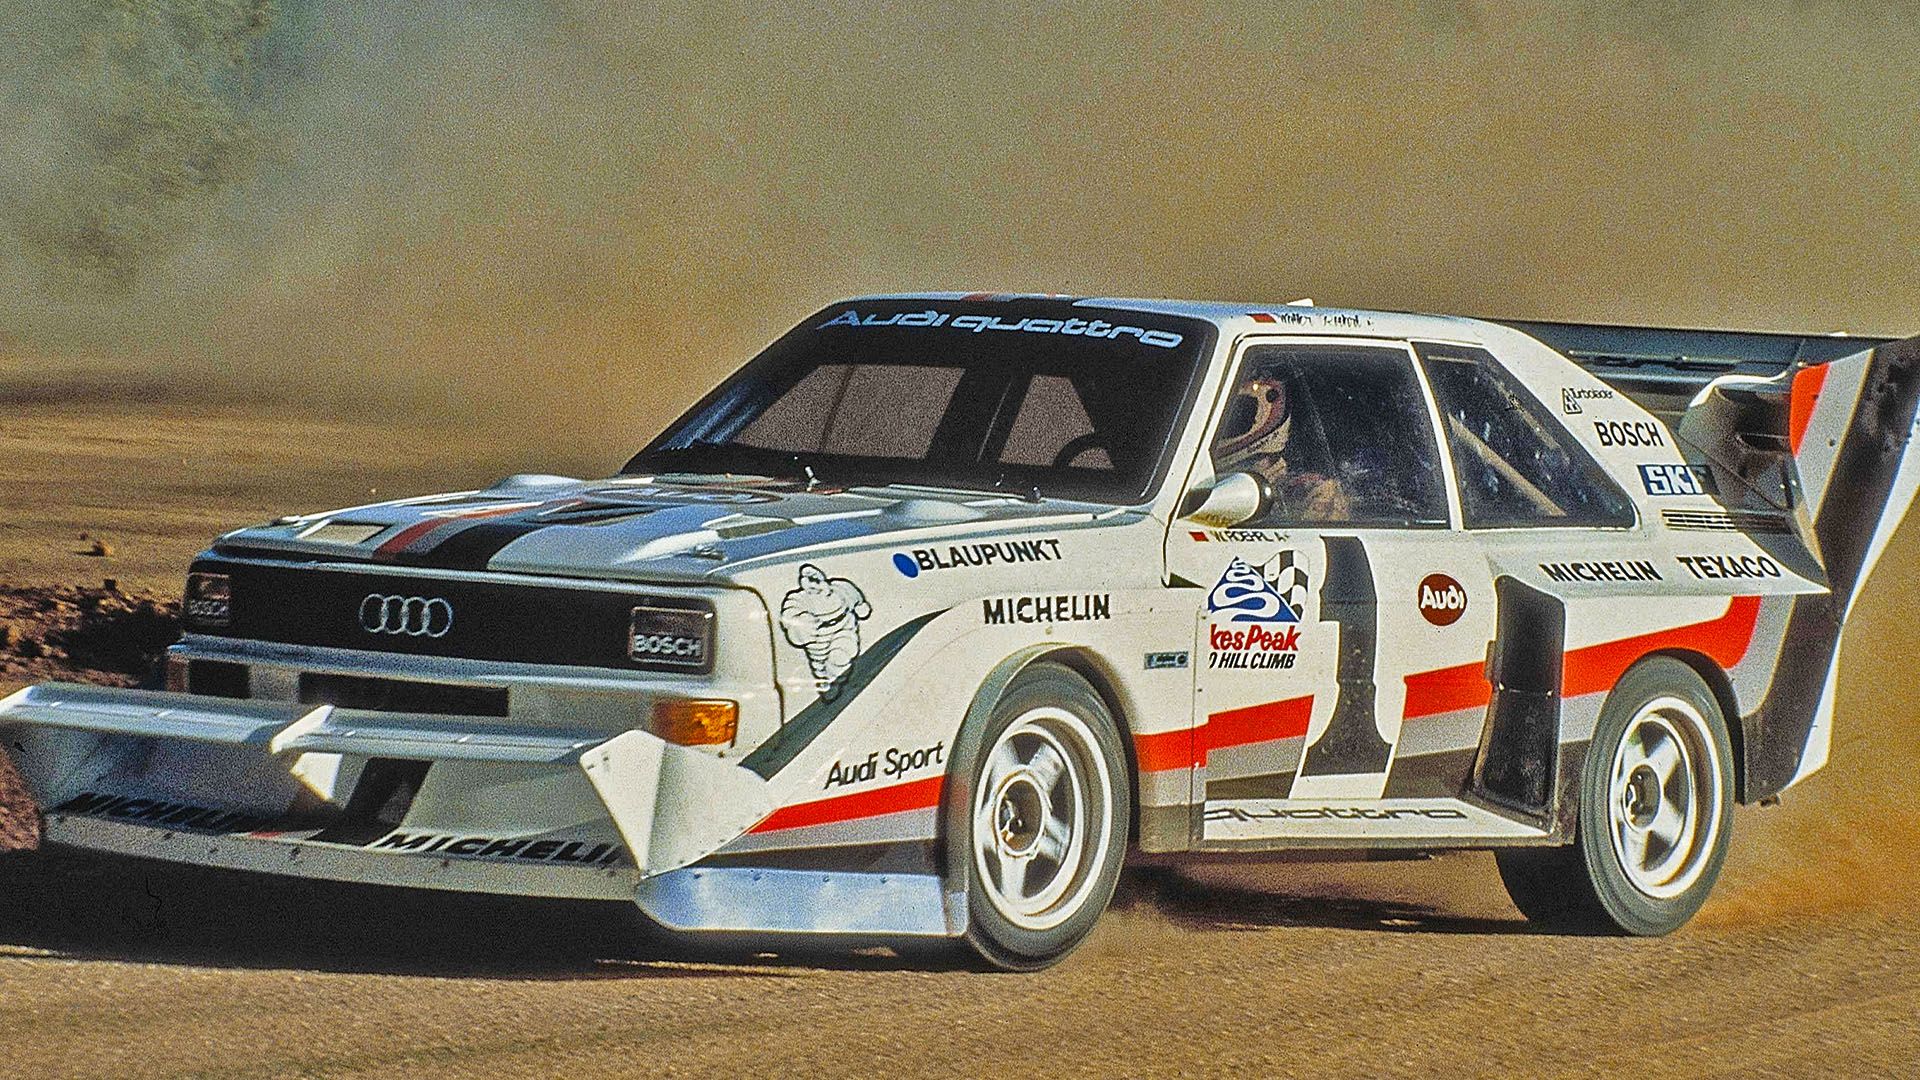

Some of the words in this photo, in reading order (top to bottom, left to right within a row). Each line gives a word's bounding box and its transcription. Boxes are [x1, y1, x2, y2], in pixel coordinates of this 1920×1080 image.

[815, 310, 945, 330] Audi
[949, 313, 1184, 348] quattro
[1595, 421, 1664, 447] BOSCH
[912, 539, 1064, 570] BLAUPUNKT
[1539, 560, 1663, 581] MICHELIN
[1676, 556, 1781, 579] TEXACO
[983, 594, 1110, 625] MICHELIN
[1420, 585, 1464, 609] Audi
[633, 634, 702, 656] BOSCH
[1244, 624, 1301, 651] Peak
[1218, 652, 1249, 669] HILL
[1250, 652, 1296, 669] CLIMB
[1300, 535, 1394, 777] 1
[824, 751, 879, 790] Audi
[884, 741, 944, 779] Sport
[1204, 807, 1468, 821] quattro
